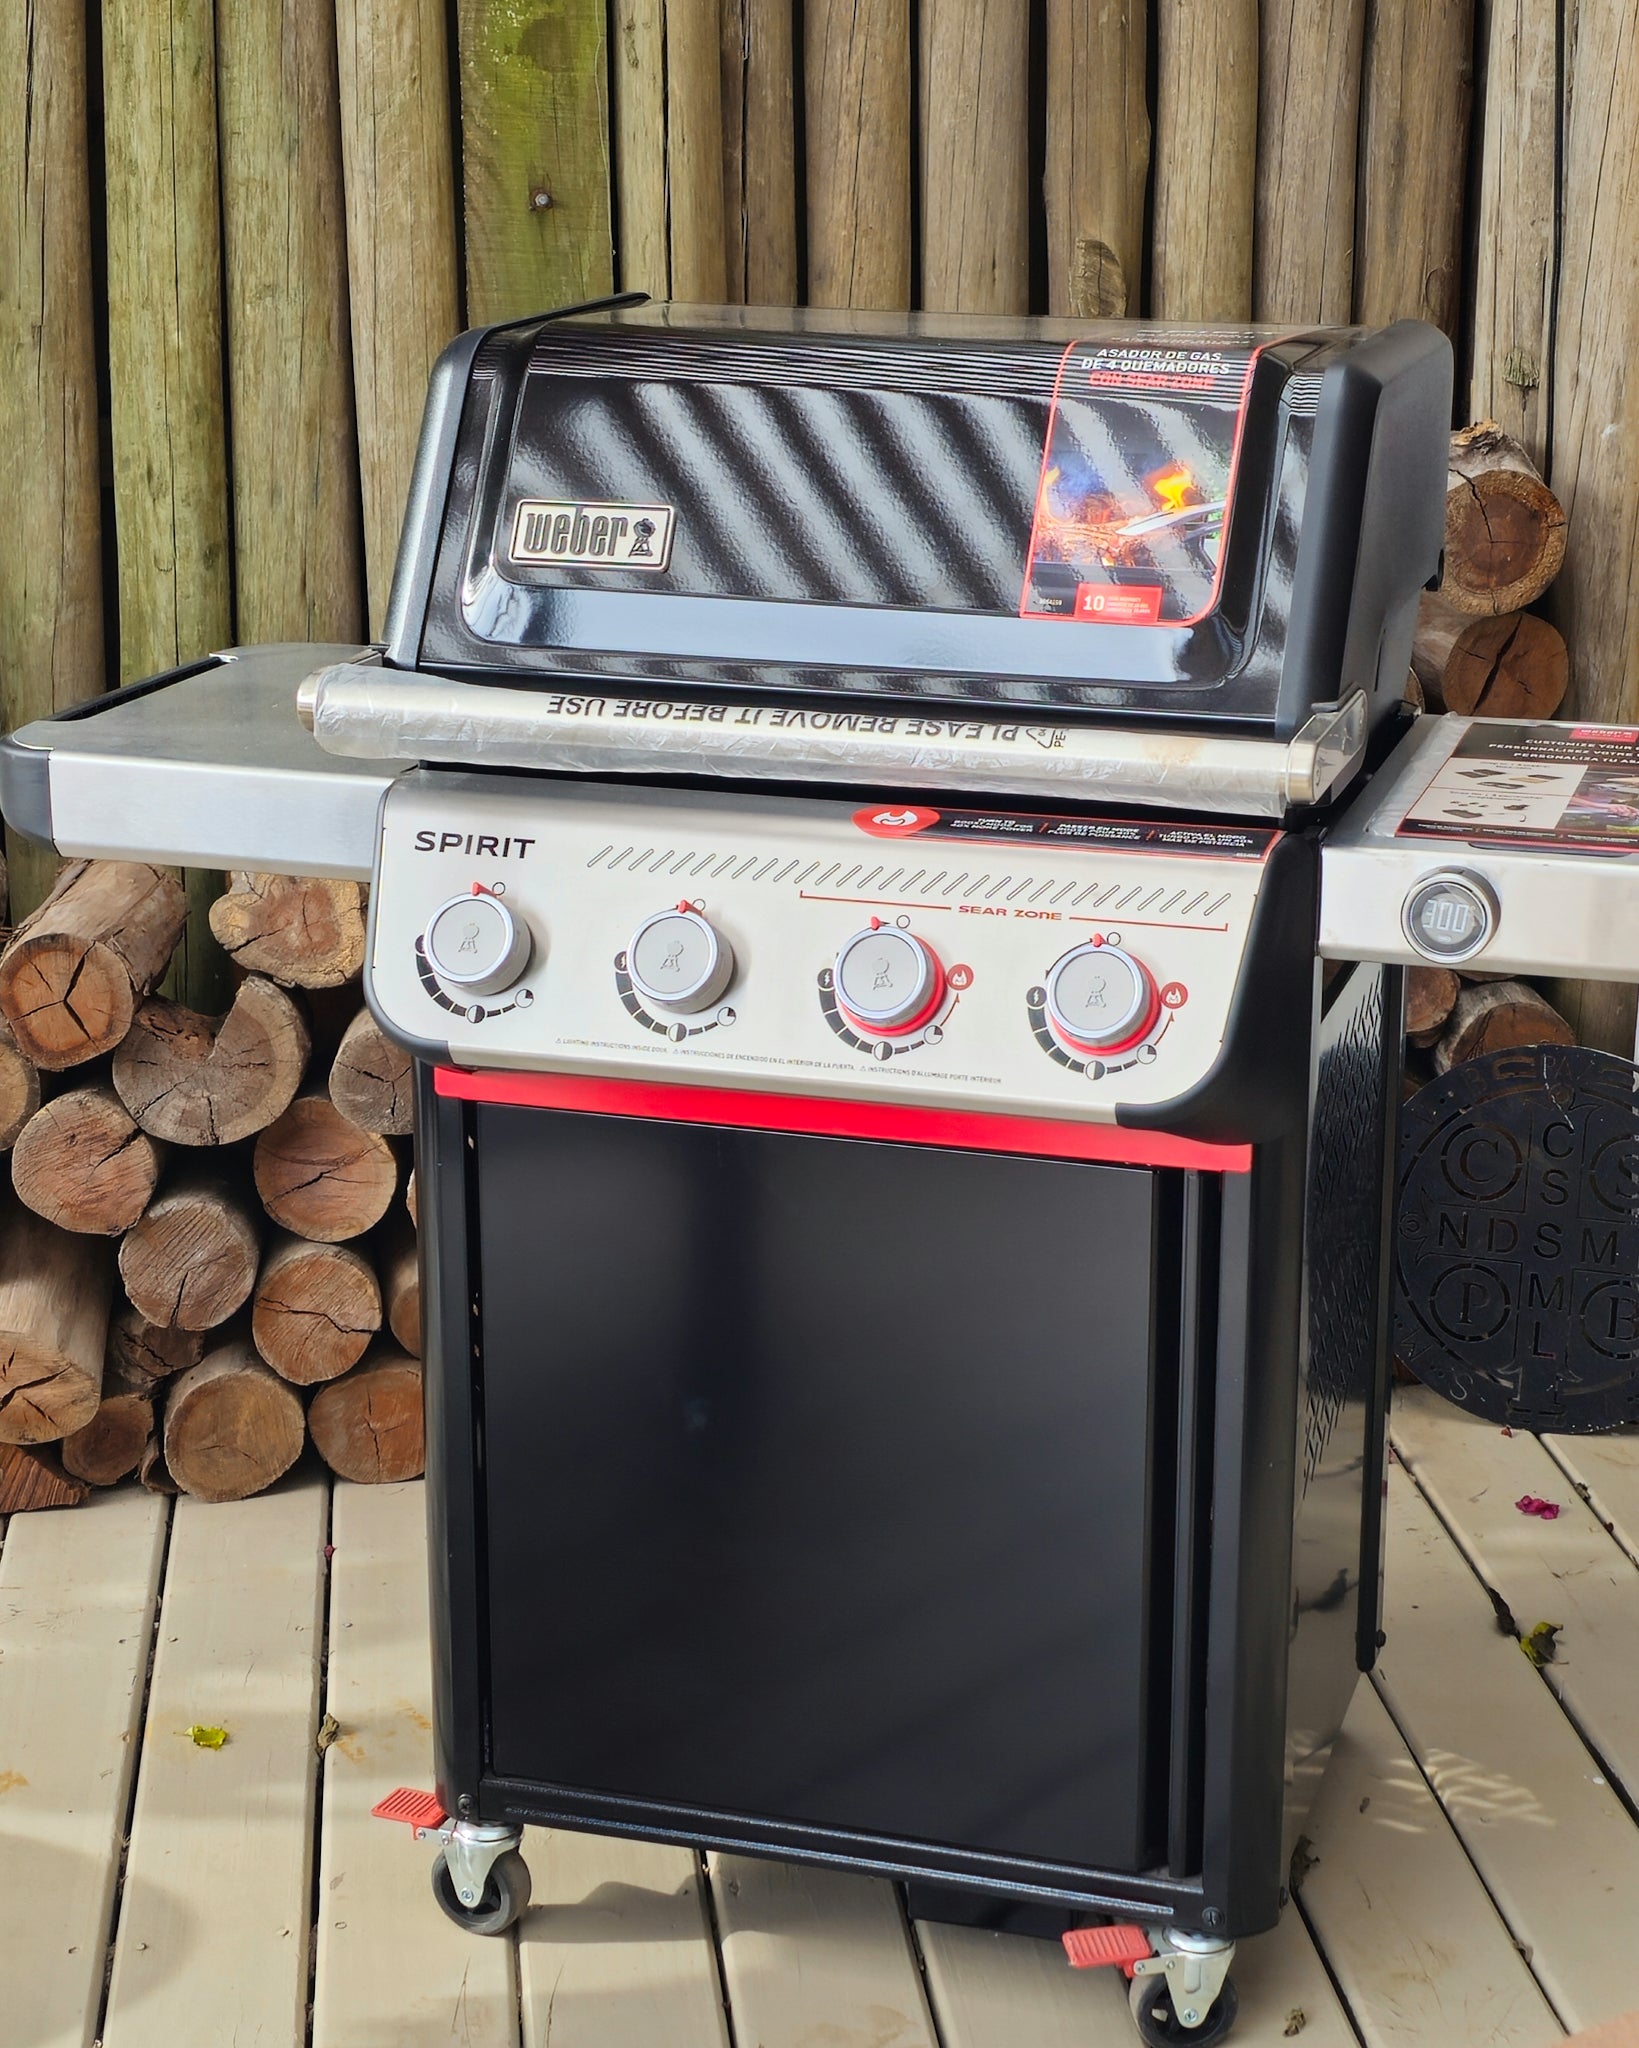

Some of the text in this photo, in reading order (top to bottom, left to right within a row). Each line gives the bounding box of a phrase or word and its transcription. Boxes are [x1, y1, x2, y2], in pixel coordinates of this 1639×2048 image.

[1096, 348, 1222, 361] ASADOR DE GAS
[1081, 358, 1231, 375] DE 4 QUEMADORES
[523, 505, 629, 557] weber
[1082, 595, 1105, 611] 10
[547, 695, 606, 717] USE
[613, 699, 729, 723] BEFORE
[734, 708, 761, 725] IT
[769, 709, 899, 734] REMOVE
[1488, 743, 1590, 754] PERSONNALISEZ
[1525, 739, 1596, 748] CUSTOMIZE
[1513, 752, 1599, 762] PERSONALIZA
[414, 830, 536, 859] SPIRIT
[958, 904, 1063, 921] SEAR ZONE
[1422, 899, 1470, 933] 300
[590, 1041, 630, 1050] INSTRUCTIONS
[680, 1049, 725, 1059] INSTRUCCIONES
[867, 1066, 910, 1075] INSTRUCTIONS
[1460, 1138, 1499, 1183] C
[1456, 1282, 1490, 1326] P
